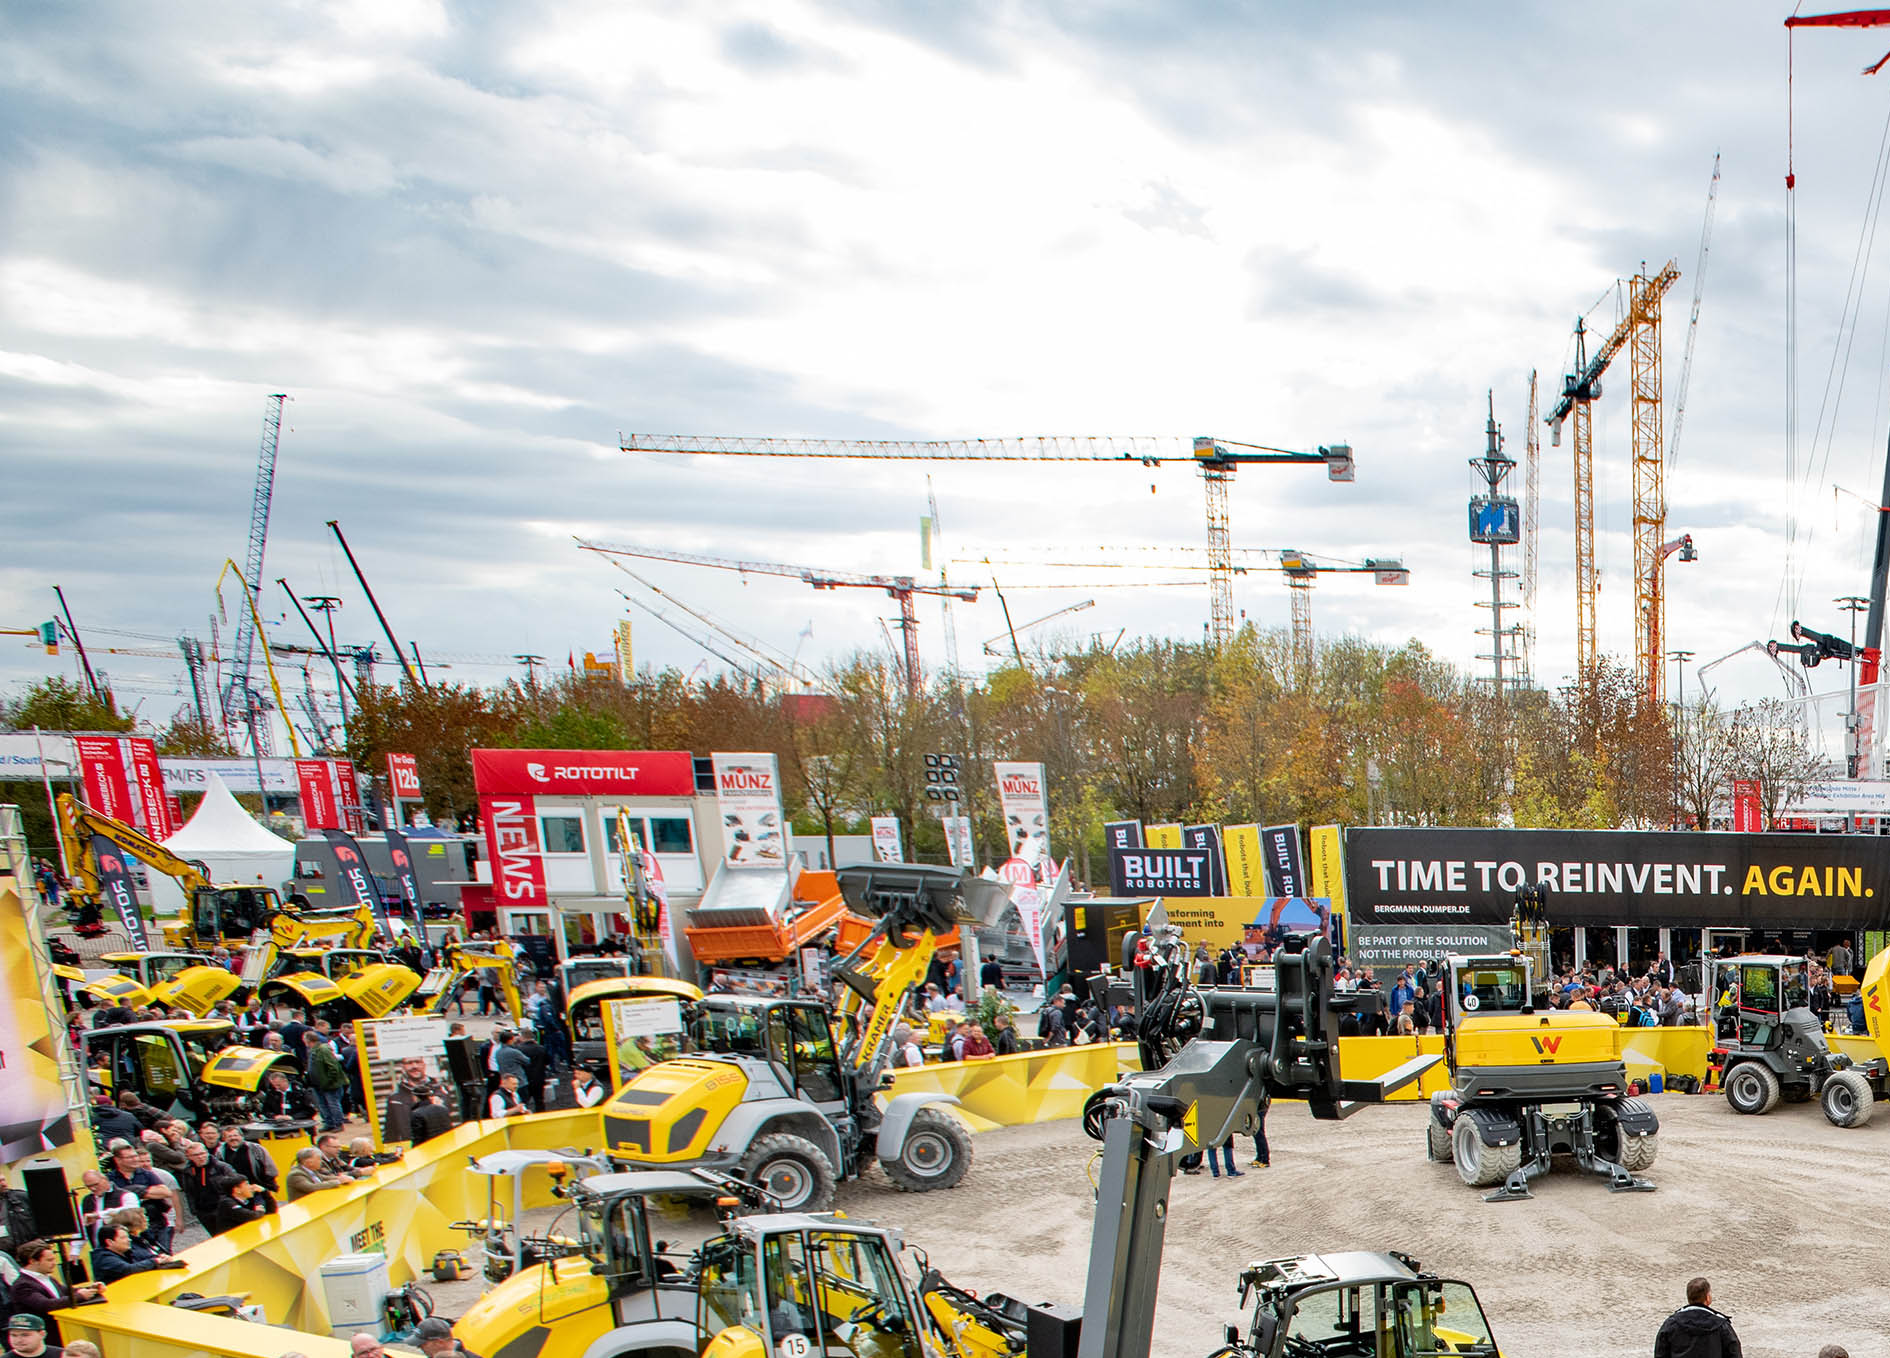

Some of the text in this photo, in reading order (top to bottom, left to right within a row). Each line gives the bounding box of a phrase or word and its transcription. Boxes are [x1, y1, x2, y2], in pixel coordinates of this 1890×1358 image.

[396, 769, 420, 790] 12b
[554, 767, 640, 780] ROTOTILT
[114, 833, 158, 859] KOMATSU
[491, 800, 535, 899] NEWS
[1273, 832, 1291, 871] BUILT
[1121, 855, 1205, 878] BUILT
[1126, 879, 1201, 889] ROBOTICS
[1371, 860, 1874, 898] TIME TO REINVENT. AGAIN.
[1374, 905, 1471, 914] BERGMANN-DUMPER.DE
[1205, 918, 1224, 928] into
[1358, 936, 1488, 946] BE PART OF THE SOLUTION
[1359, 949, 1450, 960] NOT THE PROBLEM
[1467, 998, 1477, 1008] 40
[861, 1003, 891, 1062] KRAMER
[350, 1228, 370, 1253] MEET
[369, 1220, 385, 1242] THE
[786, 1338, 805, 1356] 15
